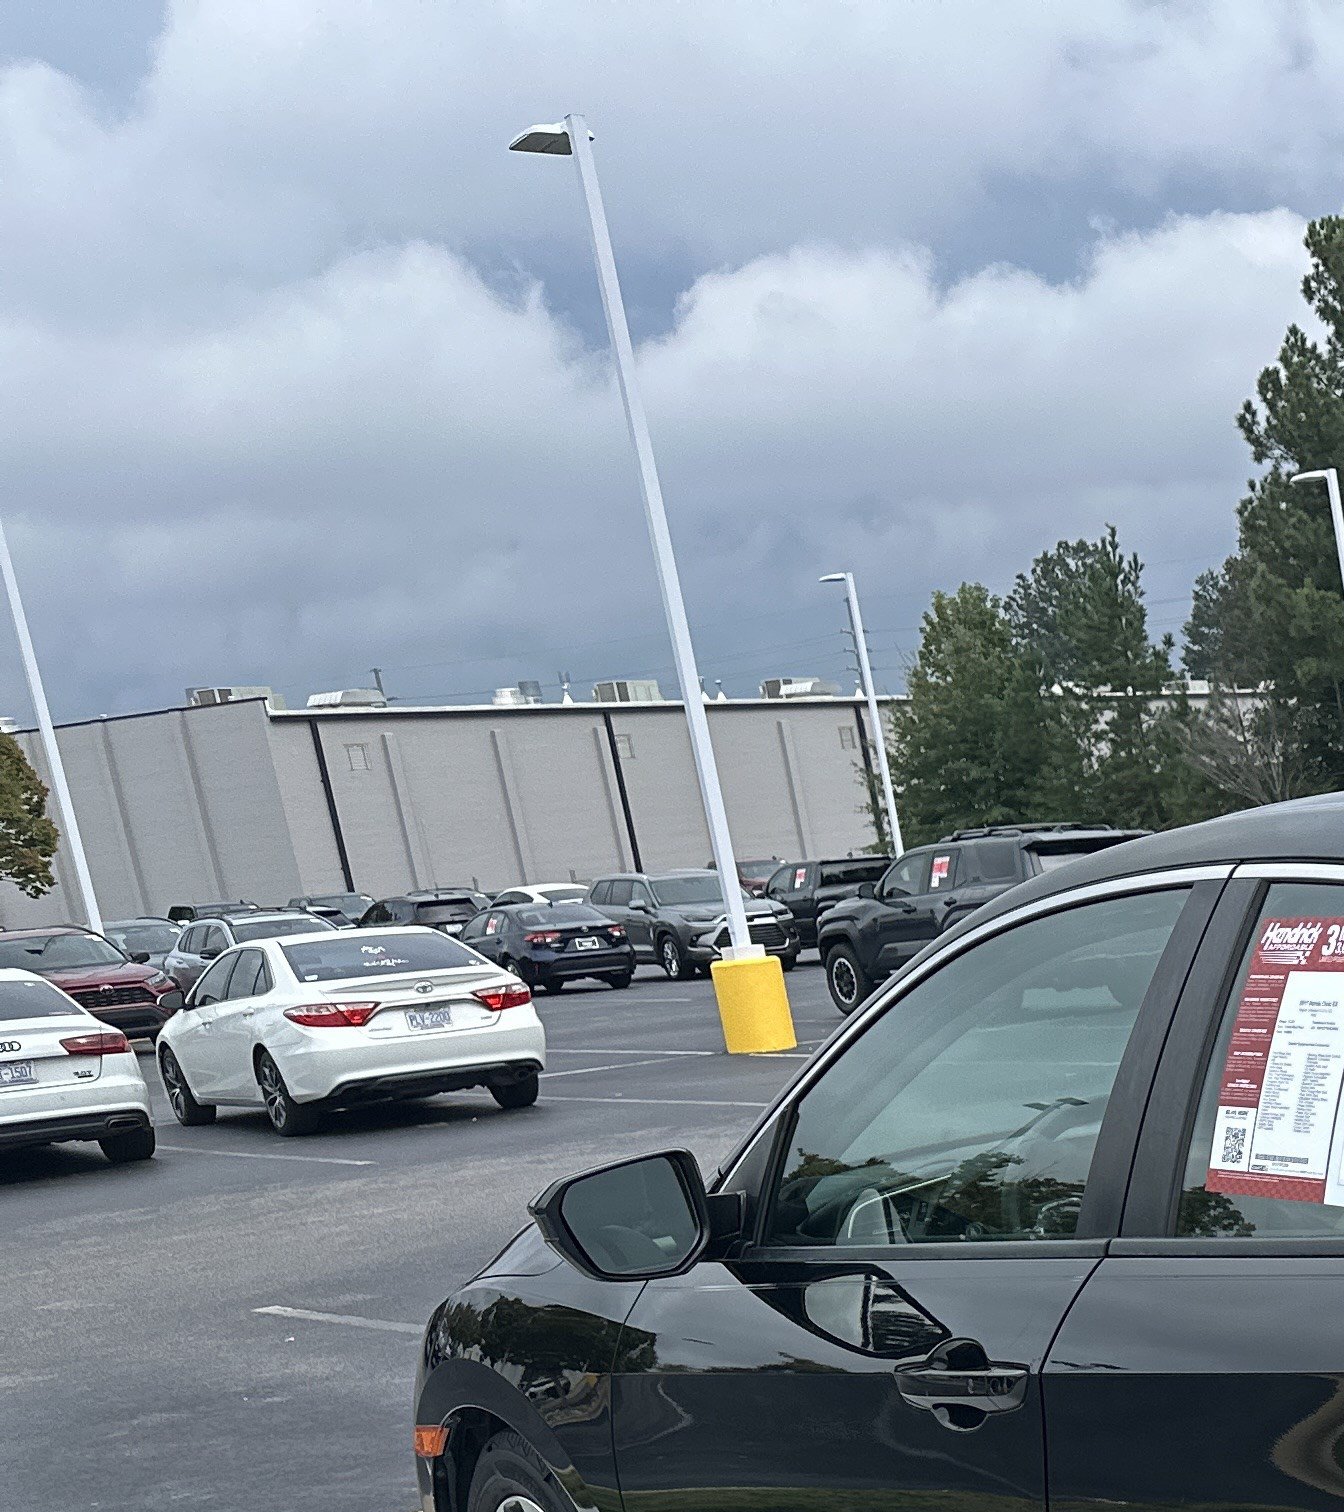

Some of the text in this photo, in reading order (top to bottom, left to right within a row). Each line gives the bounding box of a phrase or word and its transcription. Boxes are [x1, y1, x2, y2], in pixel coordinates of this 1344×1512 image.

[1261, 922, 1323, 950] Hendrick
[1321, 924, 1340, 956] 3
[0, 1064, 32, 1079] -1507
